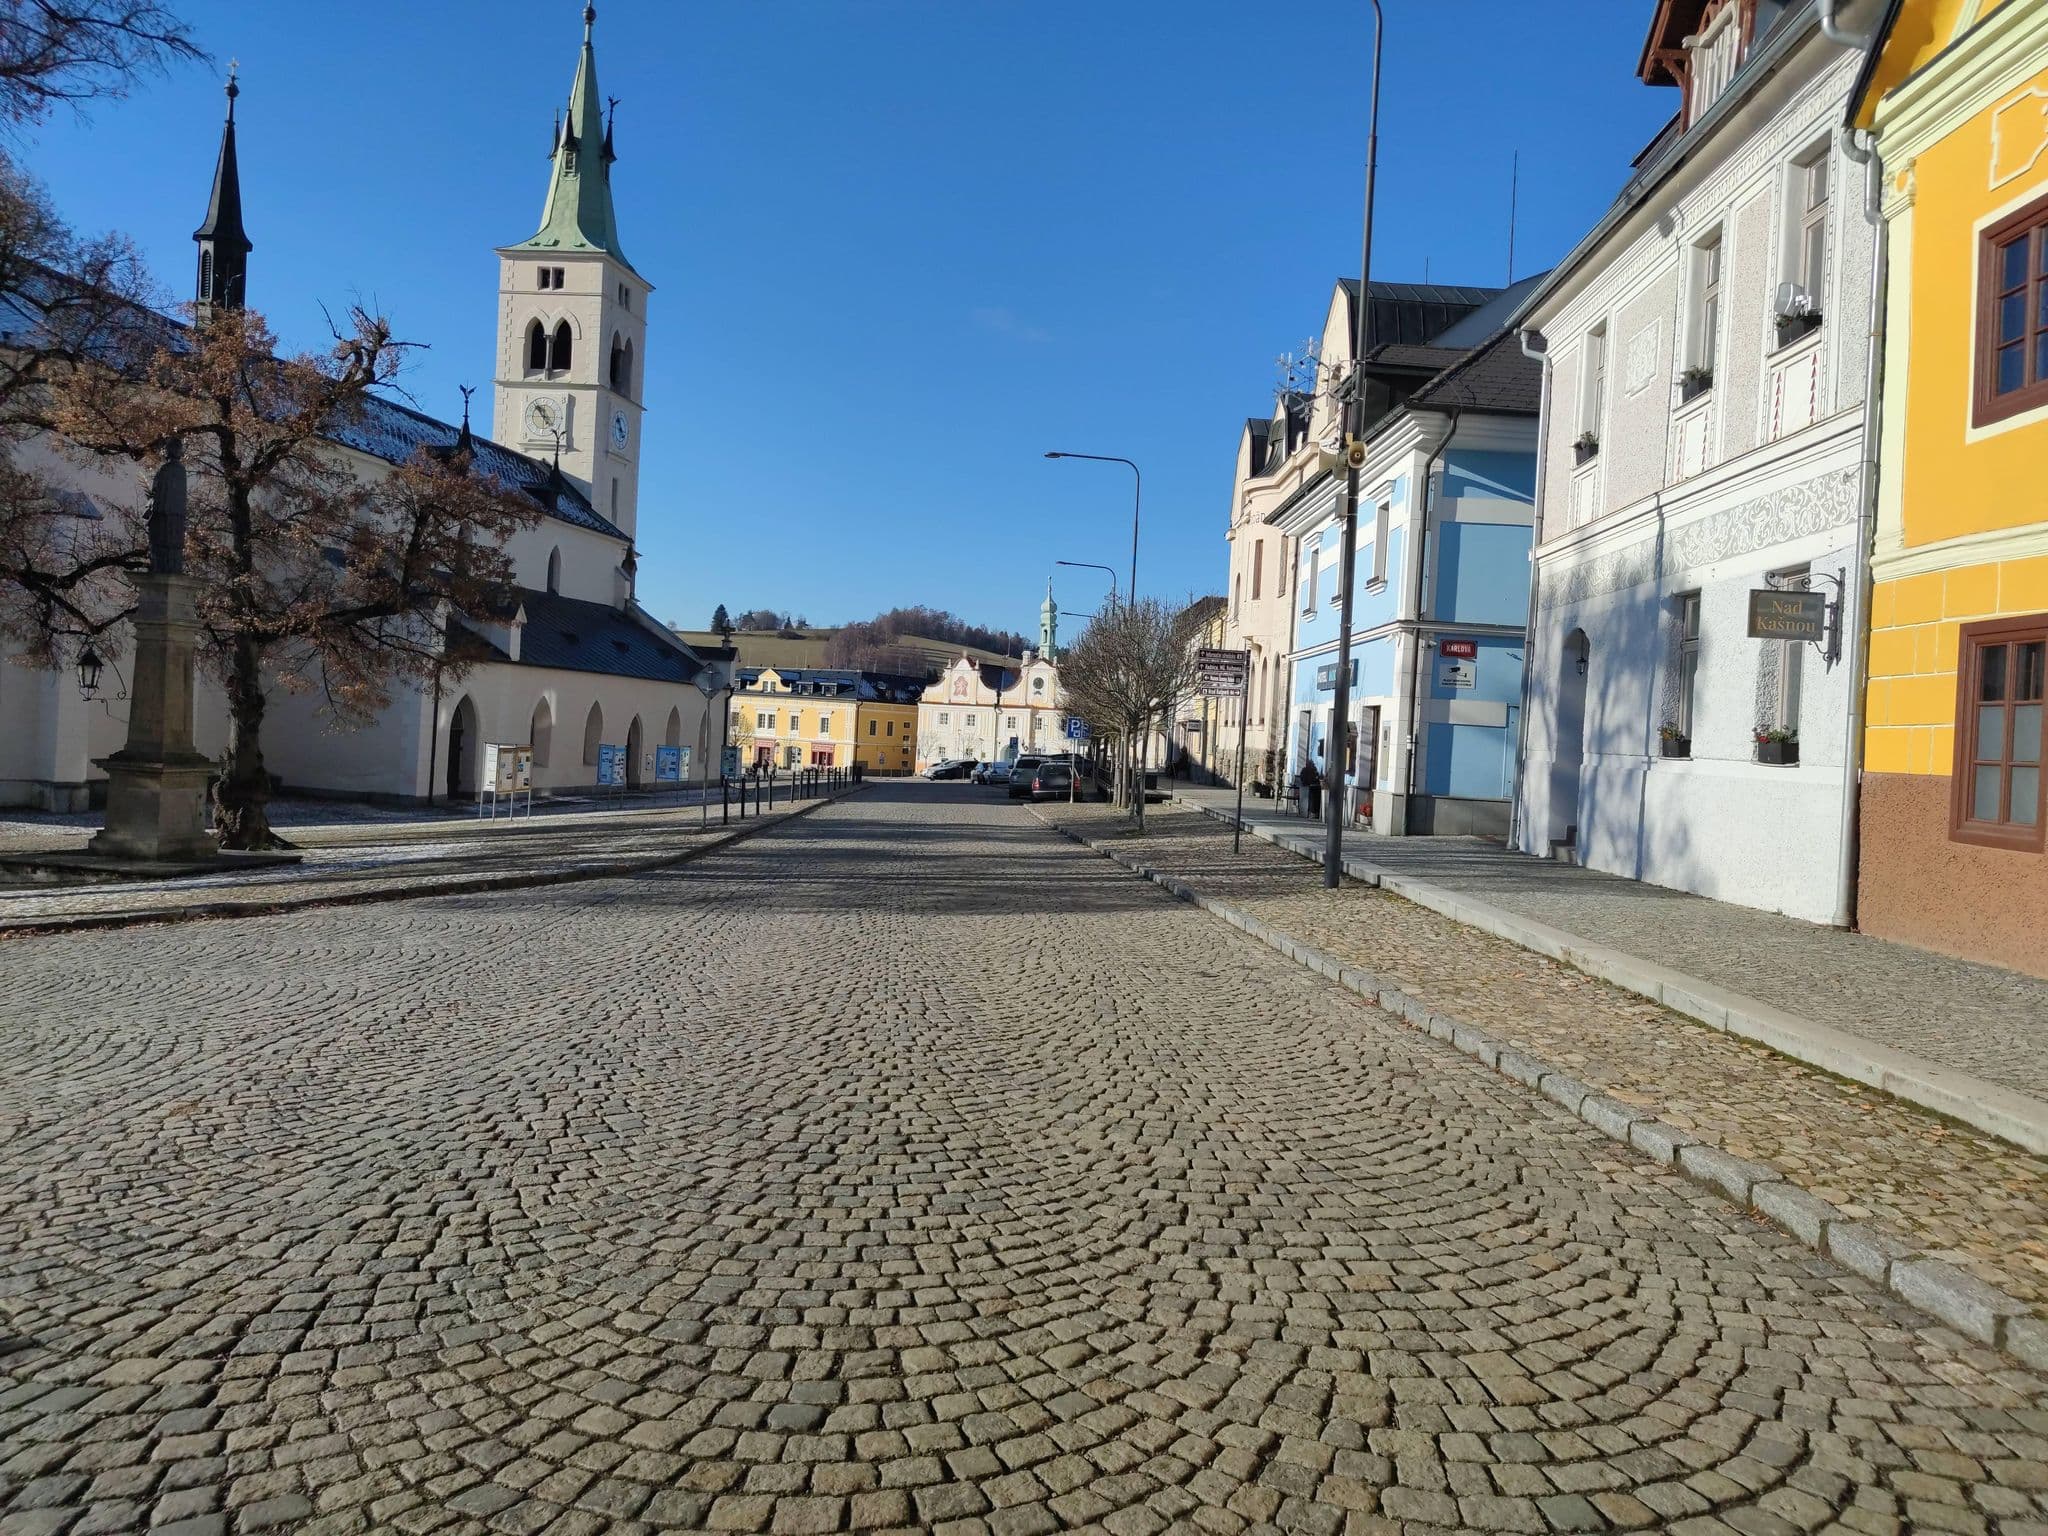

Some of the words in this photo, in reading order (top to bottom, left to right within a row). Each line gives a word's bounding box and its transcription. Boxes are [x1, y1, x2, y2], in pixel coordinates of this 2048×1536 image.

[1771, 600, 1802, 615] Nad
[1757, 616, 1816, 633] Kašnou
[1071, 719, 1080, 732] P
